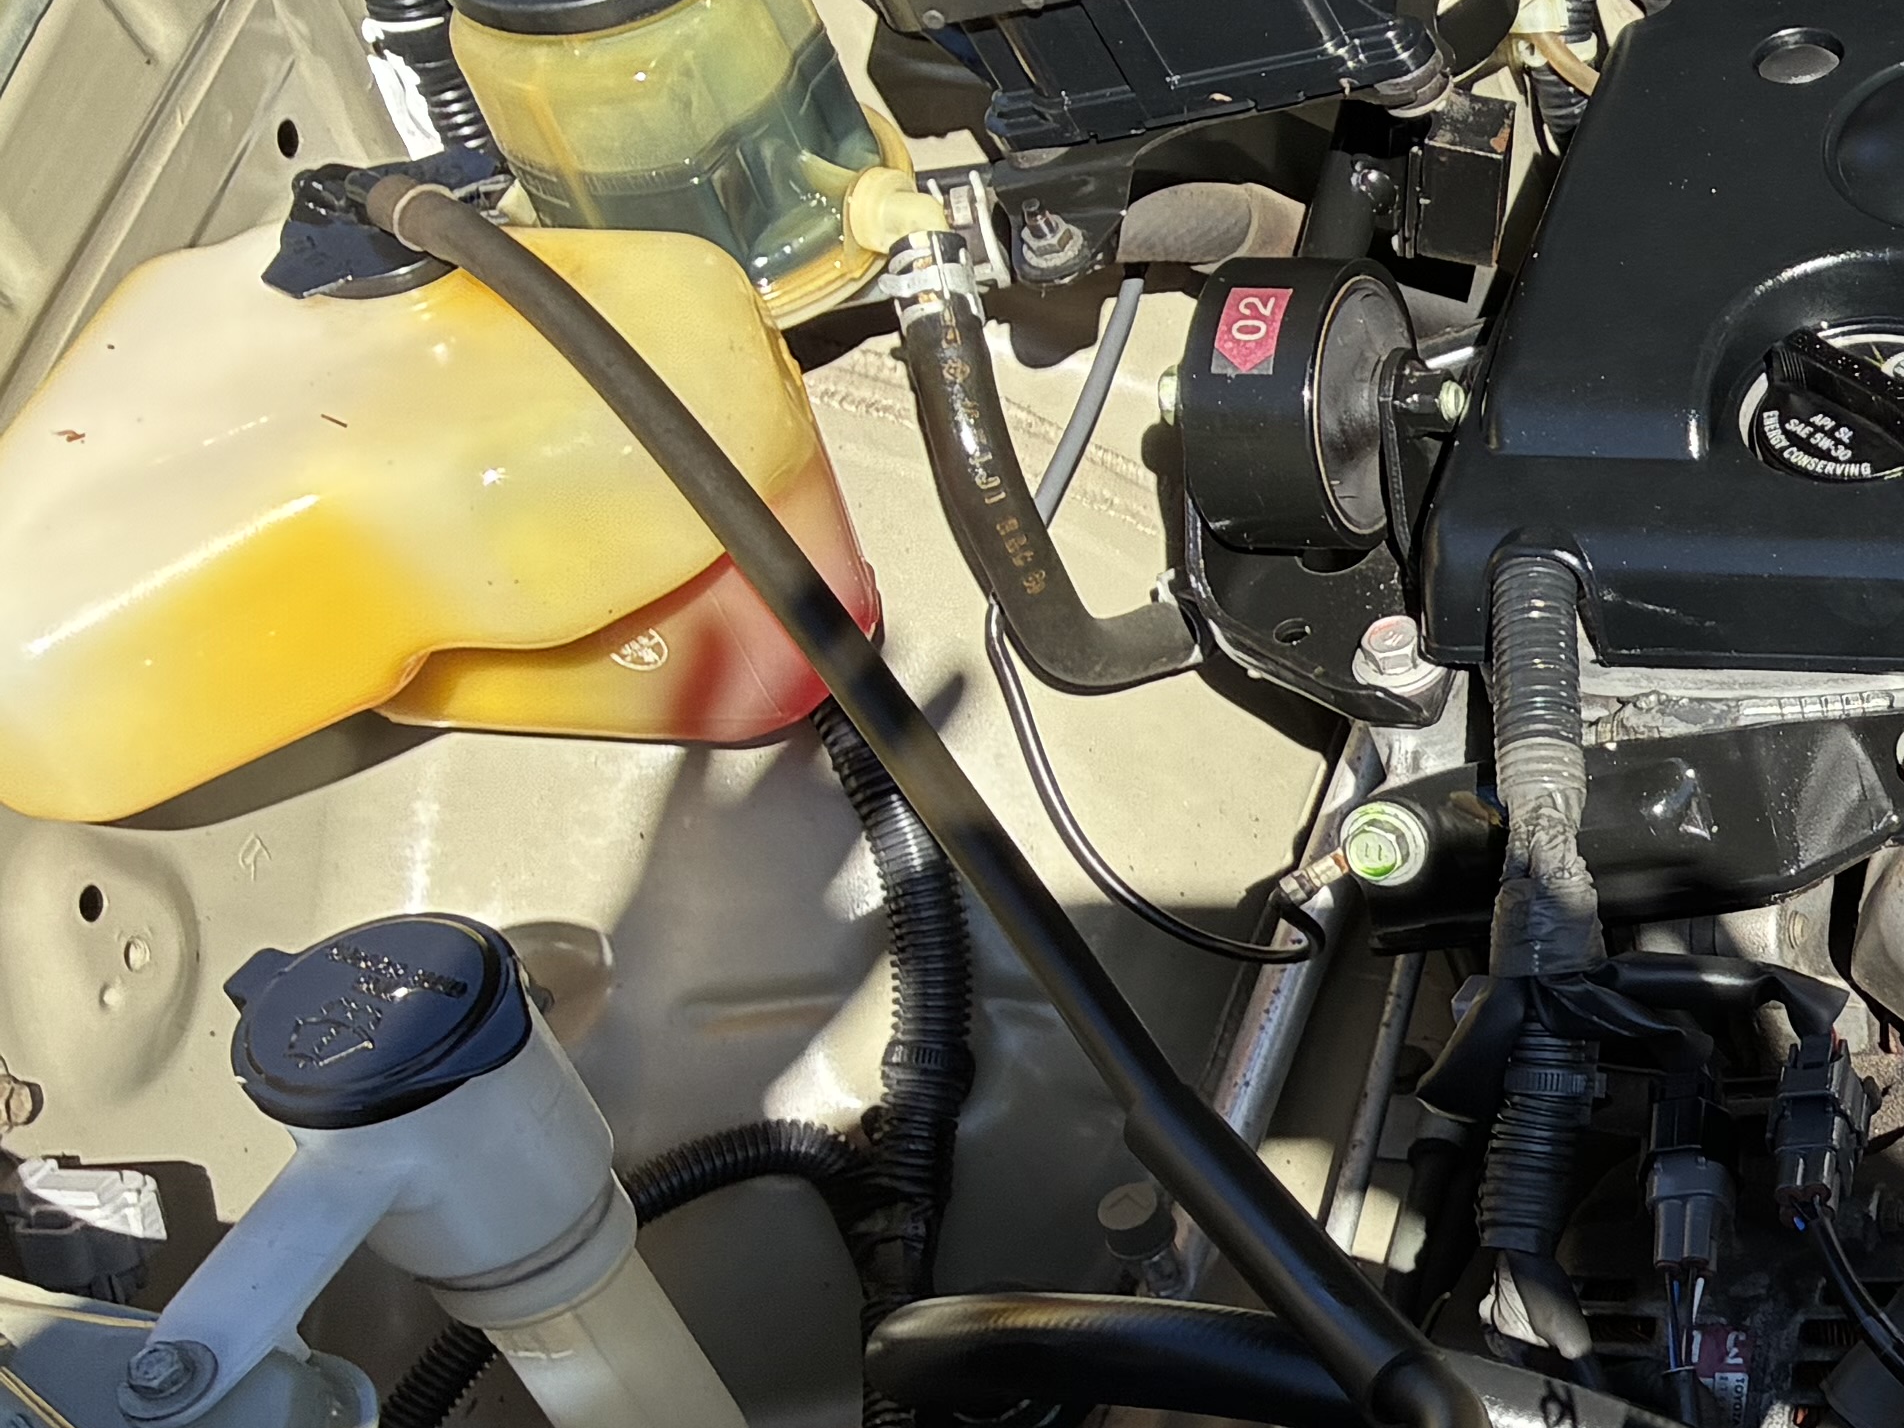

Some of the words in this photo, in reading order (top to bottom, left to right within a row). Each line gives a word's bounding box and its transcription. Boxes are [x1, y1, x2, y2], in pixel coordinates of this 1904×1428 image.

[1232, 296, 1276, 341] 02
[1762, 410, 1788, 450] ENERGY
[1783, 446, 1872, 478] CONSERVING
[1785, 418, 1807, 439] SAE
[1810, 432, 1853, 461] 5W-30
[1810, 413, 1836, 431] API
[1835, 426, 1854, 444] SL
[1732, 1377, 1746, 1425] TOYOTA
